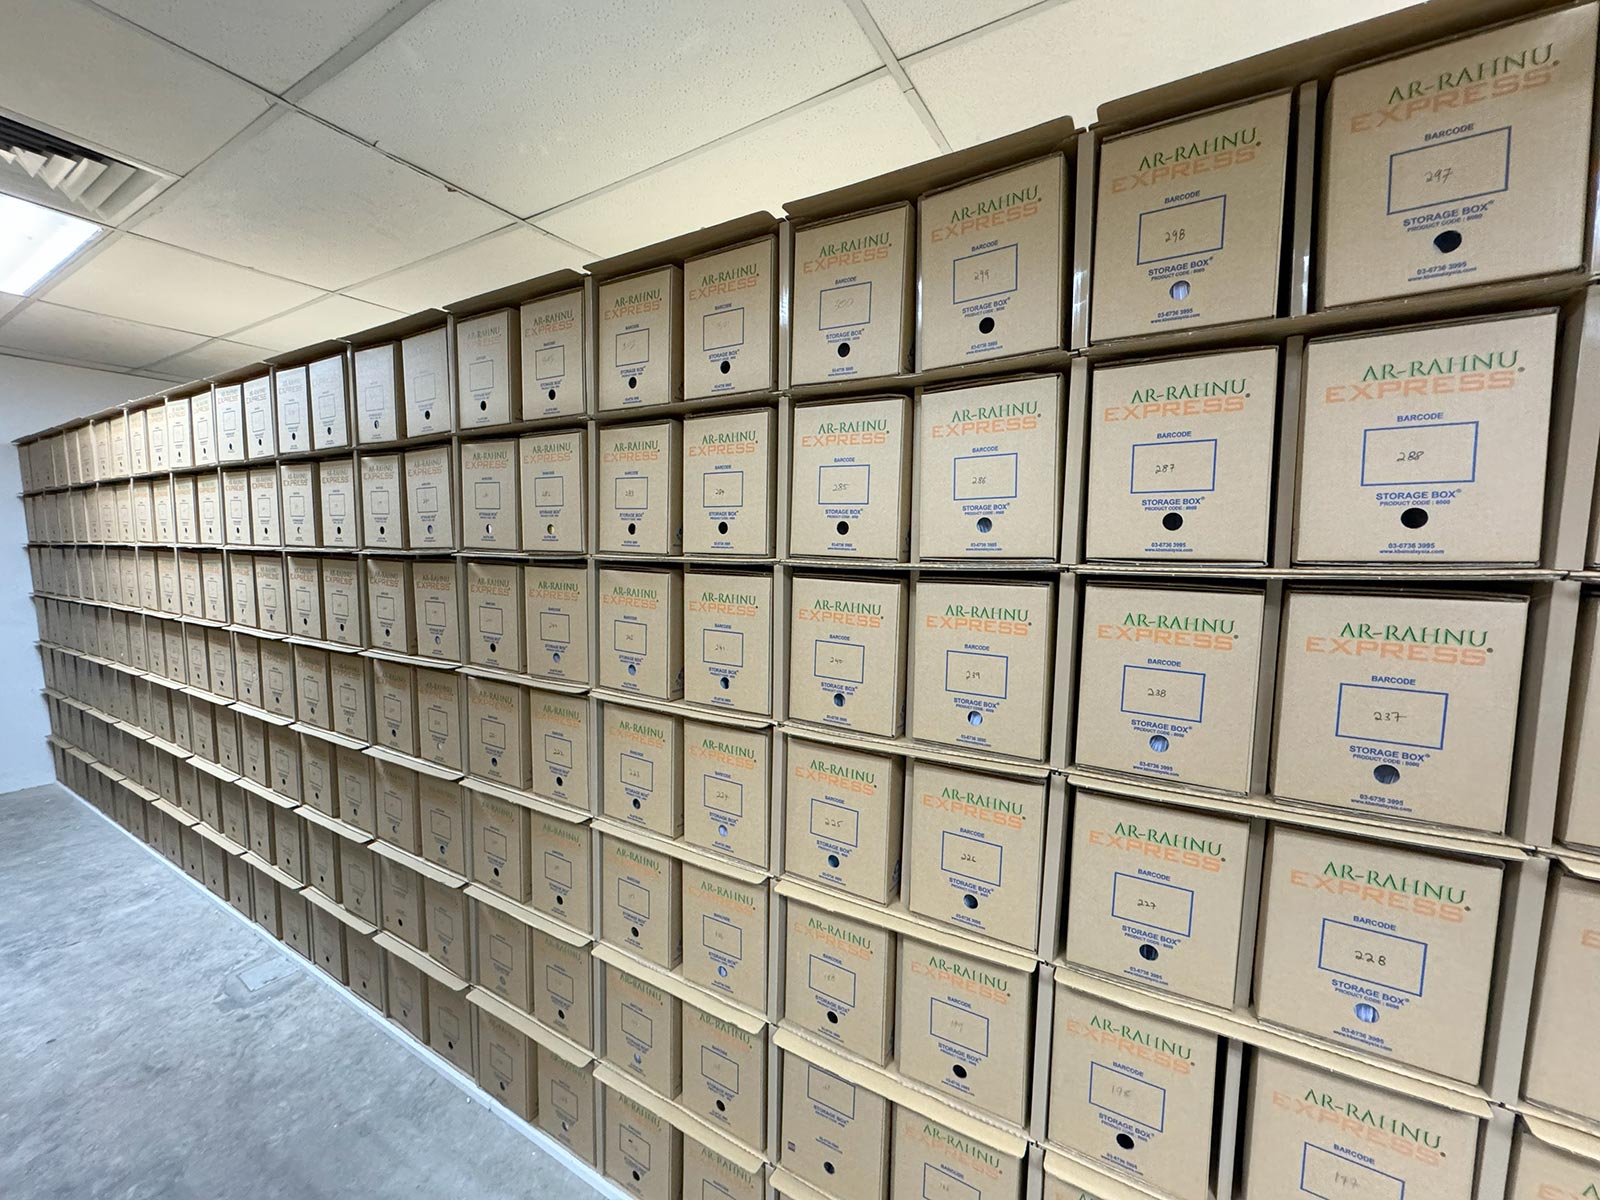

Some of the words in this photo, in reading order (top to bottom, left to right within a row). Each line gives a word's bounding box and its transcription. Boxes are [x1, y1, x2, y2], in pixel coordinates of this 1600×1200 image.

[1349, 64, 1549, 136] EXPRESS
[1424, 122, 1474, 141] BARCODE
[1110, 144, 1254, 195] EXPRESS
[1424, 166, 1452, 187] 297
[1164, 190, 1199, 204] BARCODE
[930, 199, 1037, 244] EXPRESS
[1402, 208, 1458, 227] STORAGE
[1406, 222, 1438, 233] PRODUCT
[1440, 218, 1460, 227] CODE
[1164, 227, 1186, 244] 298
[971, 238, 998, 250] BARCODE
[802, 244, 888, 275] EXPRESS
[1148, 262, 1188, 276] STORAGE
[688, 274, 756, 302] EXPRESS
[604, 298, 659, 321] EXPRESS
[962, 302, 992, 314] STORAGE
[1324, 367, 1516, 405] EXPRESS
[1103, 393, 1244, 423] EXPRESS
[1396, 412, 1443, 422] BARCODE
[931, 413, 1037, 439] EXPRESS
[802, 430, 886, 448] EXPRESS
[690, 441, 755, 456] EXPRESS
[1396, 450, 1424, 462] 288
[604, 450, 657, 464] EXPRESS
[1154, 463, 1175, 474] 287
[832, 483, 848, 492] 285
[971, 476, 986, 485] 286
[1375, 491, 1428, 500] STORAGE
[603, 594, 657, 610] EXPRESS
[689, 600, 755, 616] EXPRESS
[798, 608, 880, 629] EXPRESS
[926, 614, 1027, 637] EXPRESS
[1096, 623, 1234, 652] EXPRESS
[1303, 635, 1484, 668] EXPRESS
[1147, 657, 1181, 666] BARCODE
[965, 670, 980, 681] 239
[1370, 675, 1415, 685] BARCODE
[1147, 688, 1166, 698] 238
[954, 697, 982, 707] STORAGE
[1131, 718, 1168, 730] STORAGE
[1373, 709, 1406, 724] 237
[690, 746, 754, 771] EXPRESS
[1349, 744, 1399, 758] STORAGE
[1352, 754, 1381, 762] PRODUCT
[794, 765, 873, 797] EXPRESS
[922, 794, 1022, 830] EXPRESS
[824, 816, 843, 829] 225
[959, 827, 984, 837] BARCODE
[1087, 828, 1220, 873] EXPRESS
[1137, 868, 1170, 881] BARCODE
[949, 876, 976, 890] STORAGE
[1137, 898, 1156, 910] 227
[1288, 868, 1463, 924] EXPRESS
[1352, 915, 1395, 931] BARCODE
[1122, 924, 1158, 940] STORAGE
[793, 919, 870, 962] EXPRESS
[1354, 949, 1387, 967] 228
[908, 958, 1006, 1006] EXPRESS
[1331, 978, 1379, 998] STORAGE
[1065, 1016, 1190, 1076] EXPRESS
[1112, 1060, 1143, 1076] BARCODE
[1099, 1112, 1133, 1132] STORAGE
[1272, 1089, 1440, 1167] EXPRESS
[1332, 1143, 1374, 1164] BARCODE
